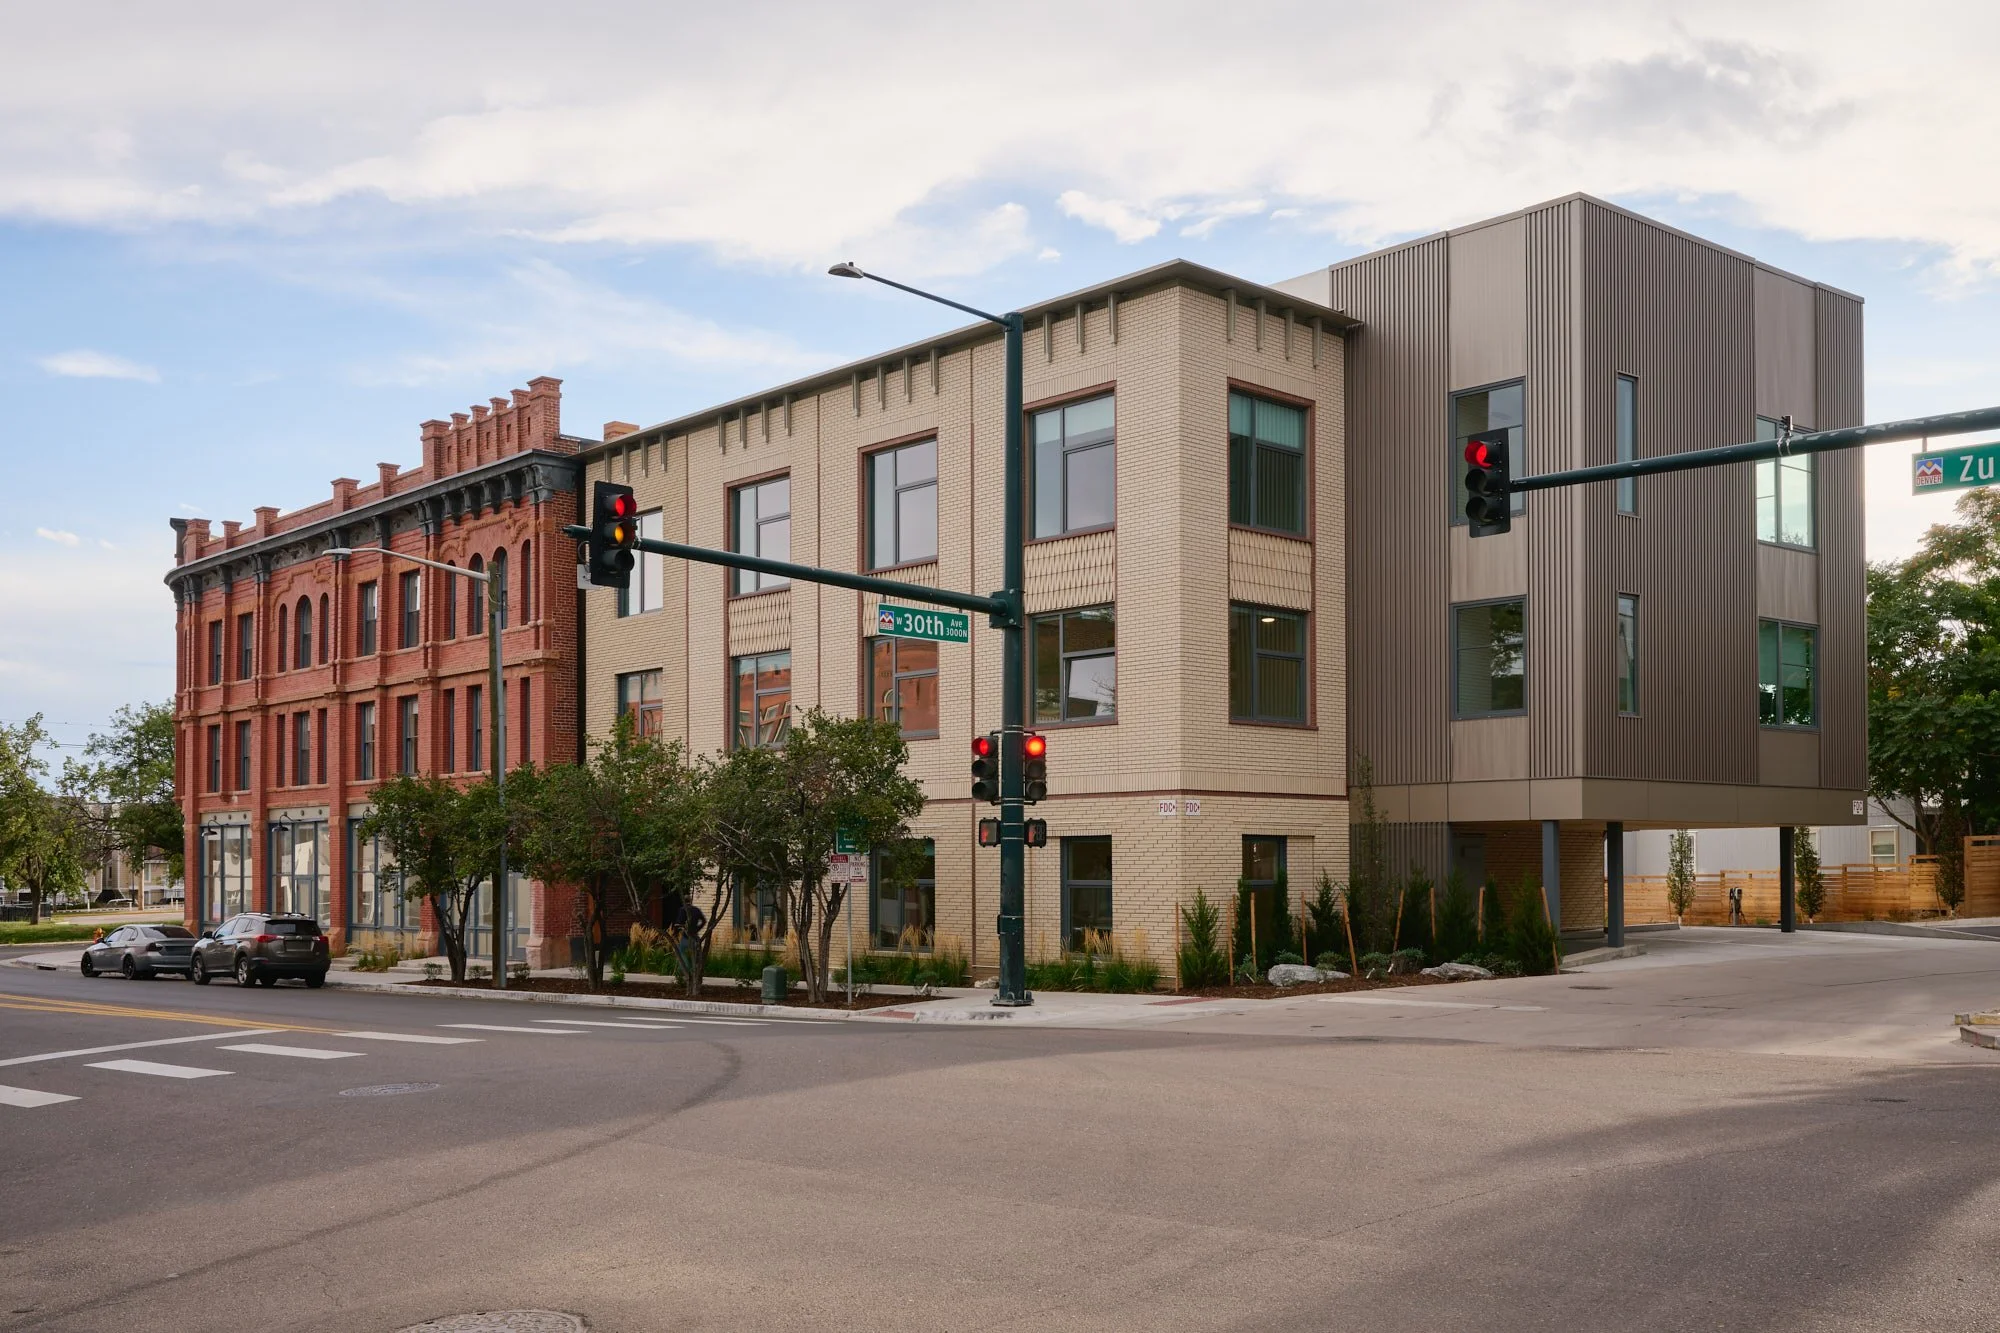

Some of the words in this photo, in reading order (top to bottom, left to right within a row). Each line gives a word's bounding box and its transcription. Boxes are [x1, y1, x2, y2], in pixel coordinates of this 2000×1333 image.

[1960, 455, 1994, 482] Zu
[1916, 476, 1942, 485] DENVER
[896, 616, 903, 625] W
[903, 613, 944, 636] 30th
[950, 618, 963, 628] Ave
[946, 628, 967, 638] 3000N
[1159, 802, 1173, 813] FDC
[1185, 802, 1198, 813] FDC
